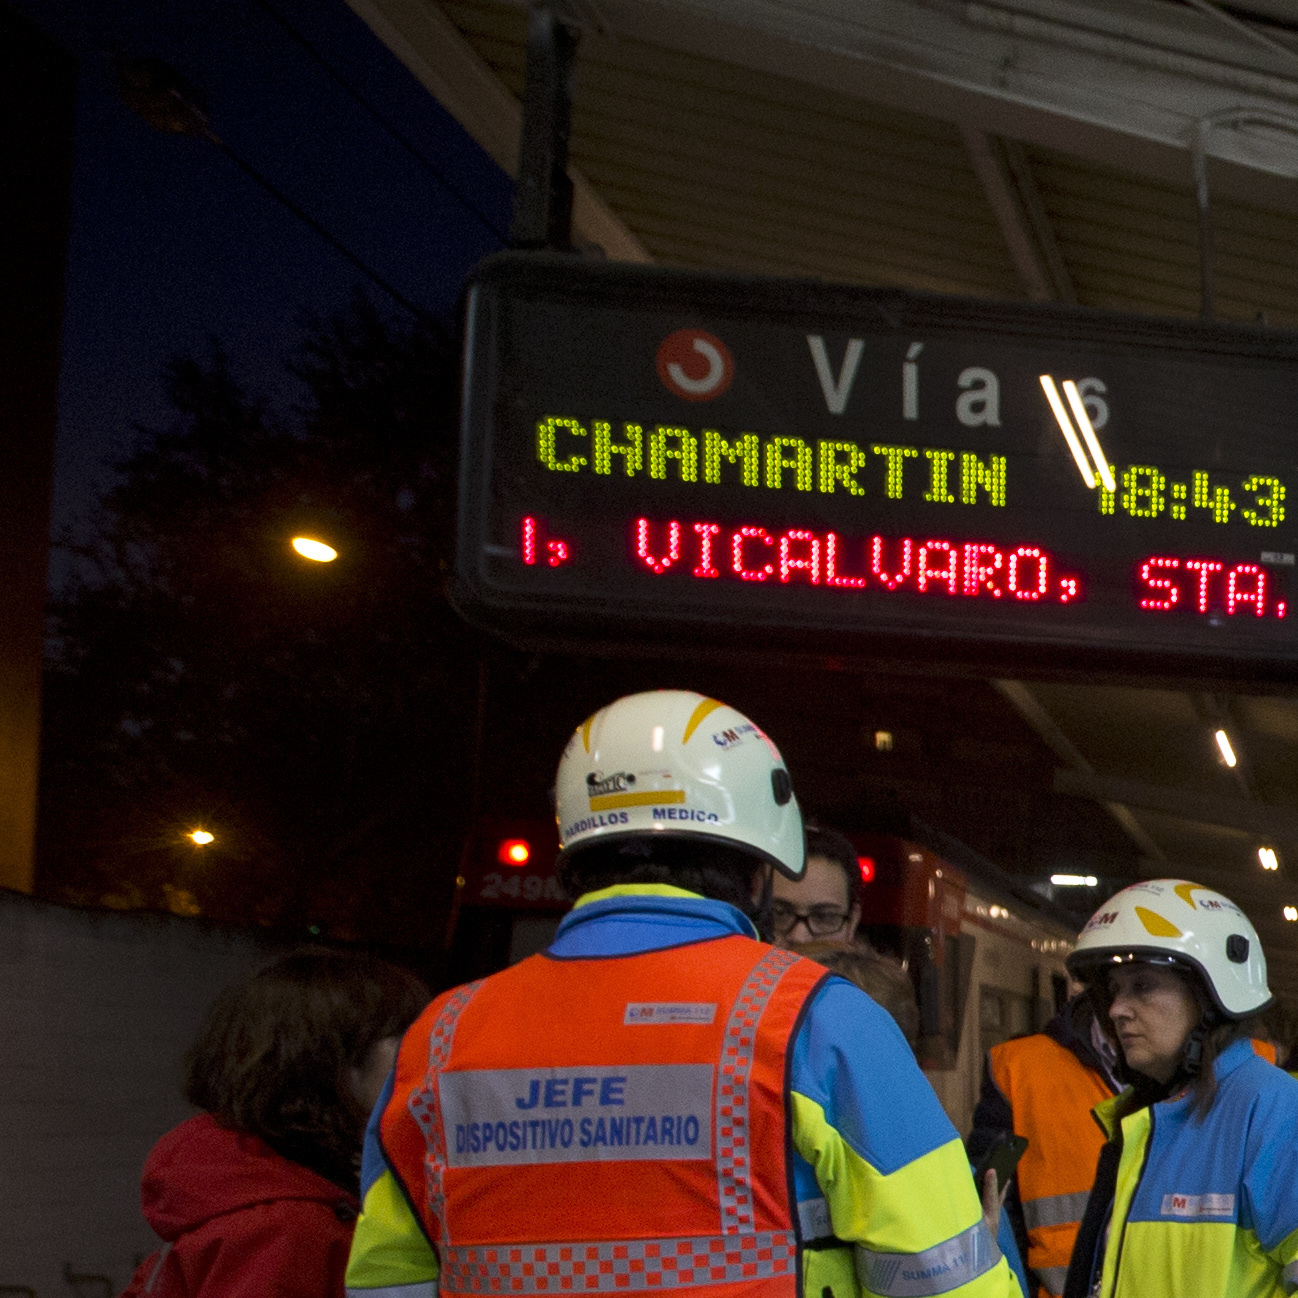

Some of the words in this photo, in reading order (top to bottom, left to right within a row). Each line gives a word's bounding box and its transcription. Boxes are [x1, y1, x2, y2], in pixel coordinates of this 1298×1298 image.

[807, 333, 1001, 428] Vía
[1075, 377, 1110, 429] 6
[535, 415, 1007, 507] CHAMARTIN
[1094, 463, 1287, 528] 18:43
[637, 516, 1078, 604] VICALVARO,
[515, 1076, 626, 1110] JEFE
[455, 1118, 573, 1154] DISPOSITIVO
[579, 1115, 699, 1148] SANITARIO
[901, 1263, 950, 1281] SUMMA
